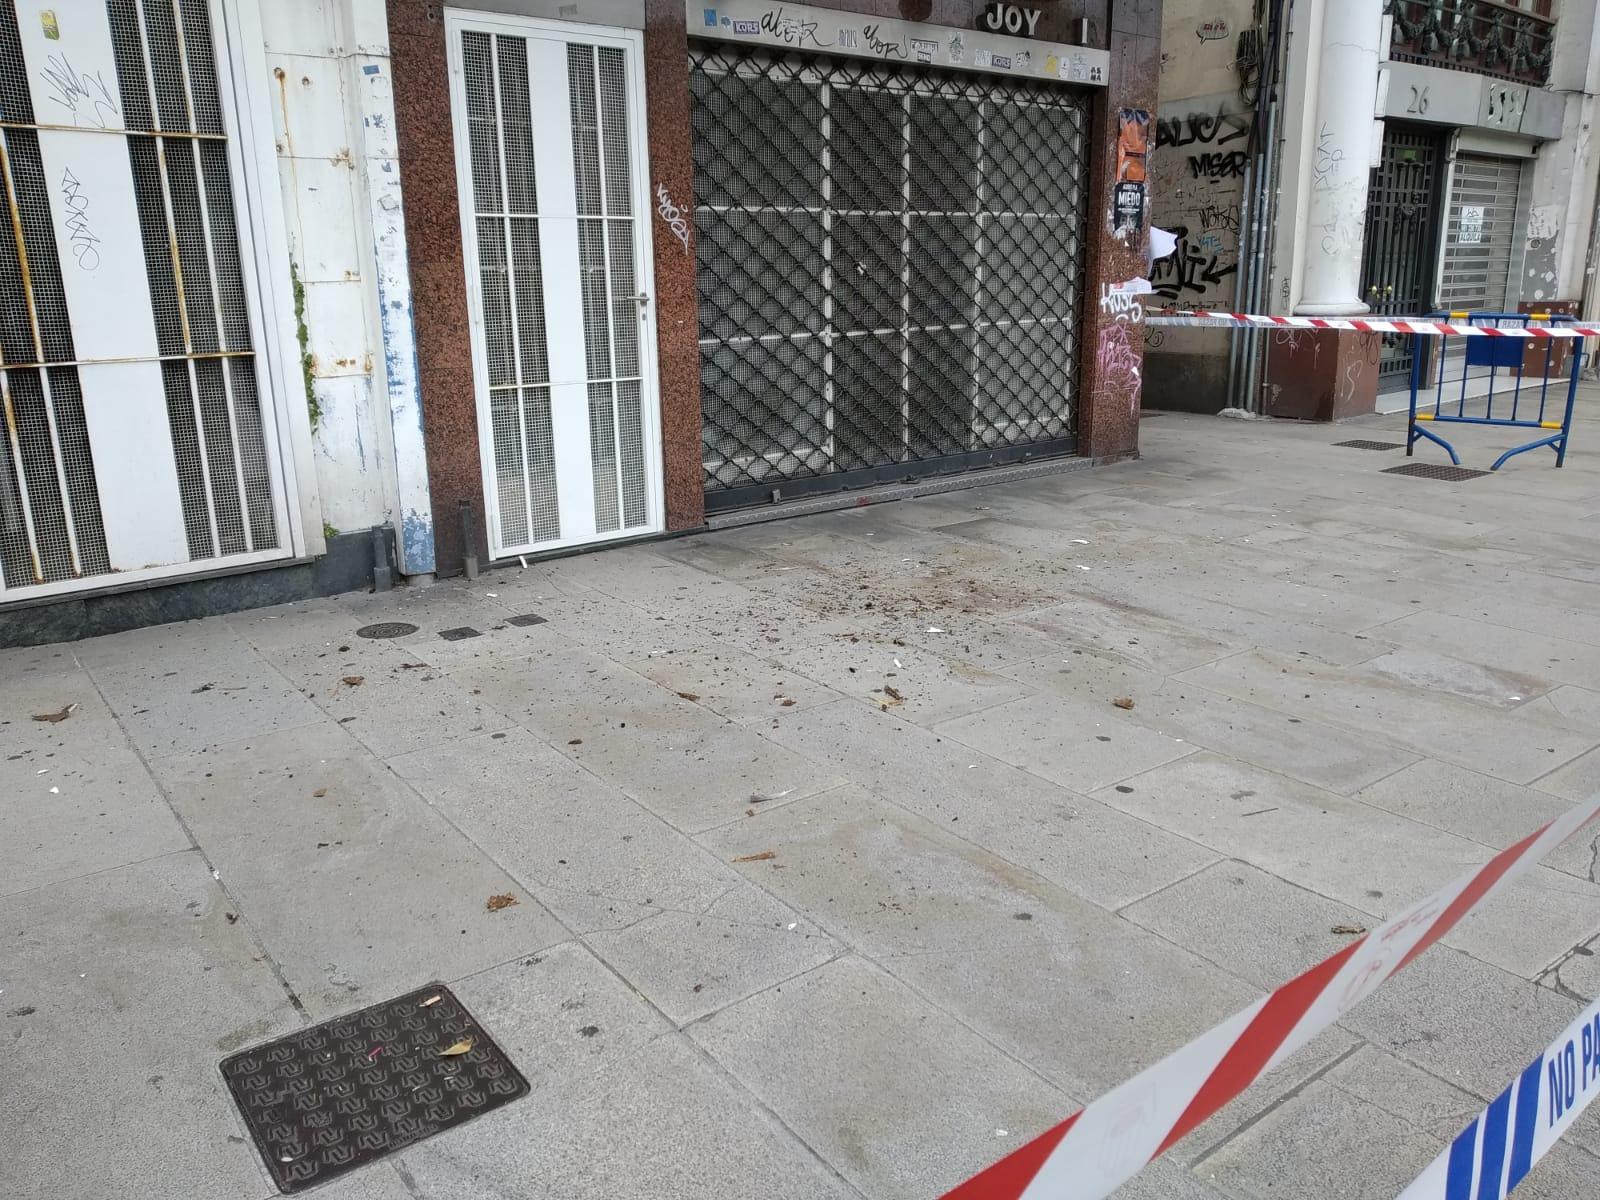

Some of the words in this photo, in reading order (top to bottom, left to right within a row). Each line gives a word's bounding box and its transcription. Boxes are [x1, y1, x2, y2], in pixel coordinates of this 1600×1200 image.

[987, 3, 1041, 35] JOY
[1407, 84, 1429, 115] 26
[1118, 191, 1140, 206] MIEDO
[1548, 1039, 1575, 1128] NO
